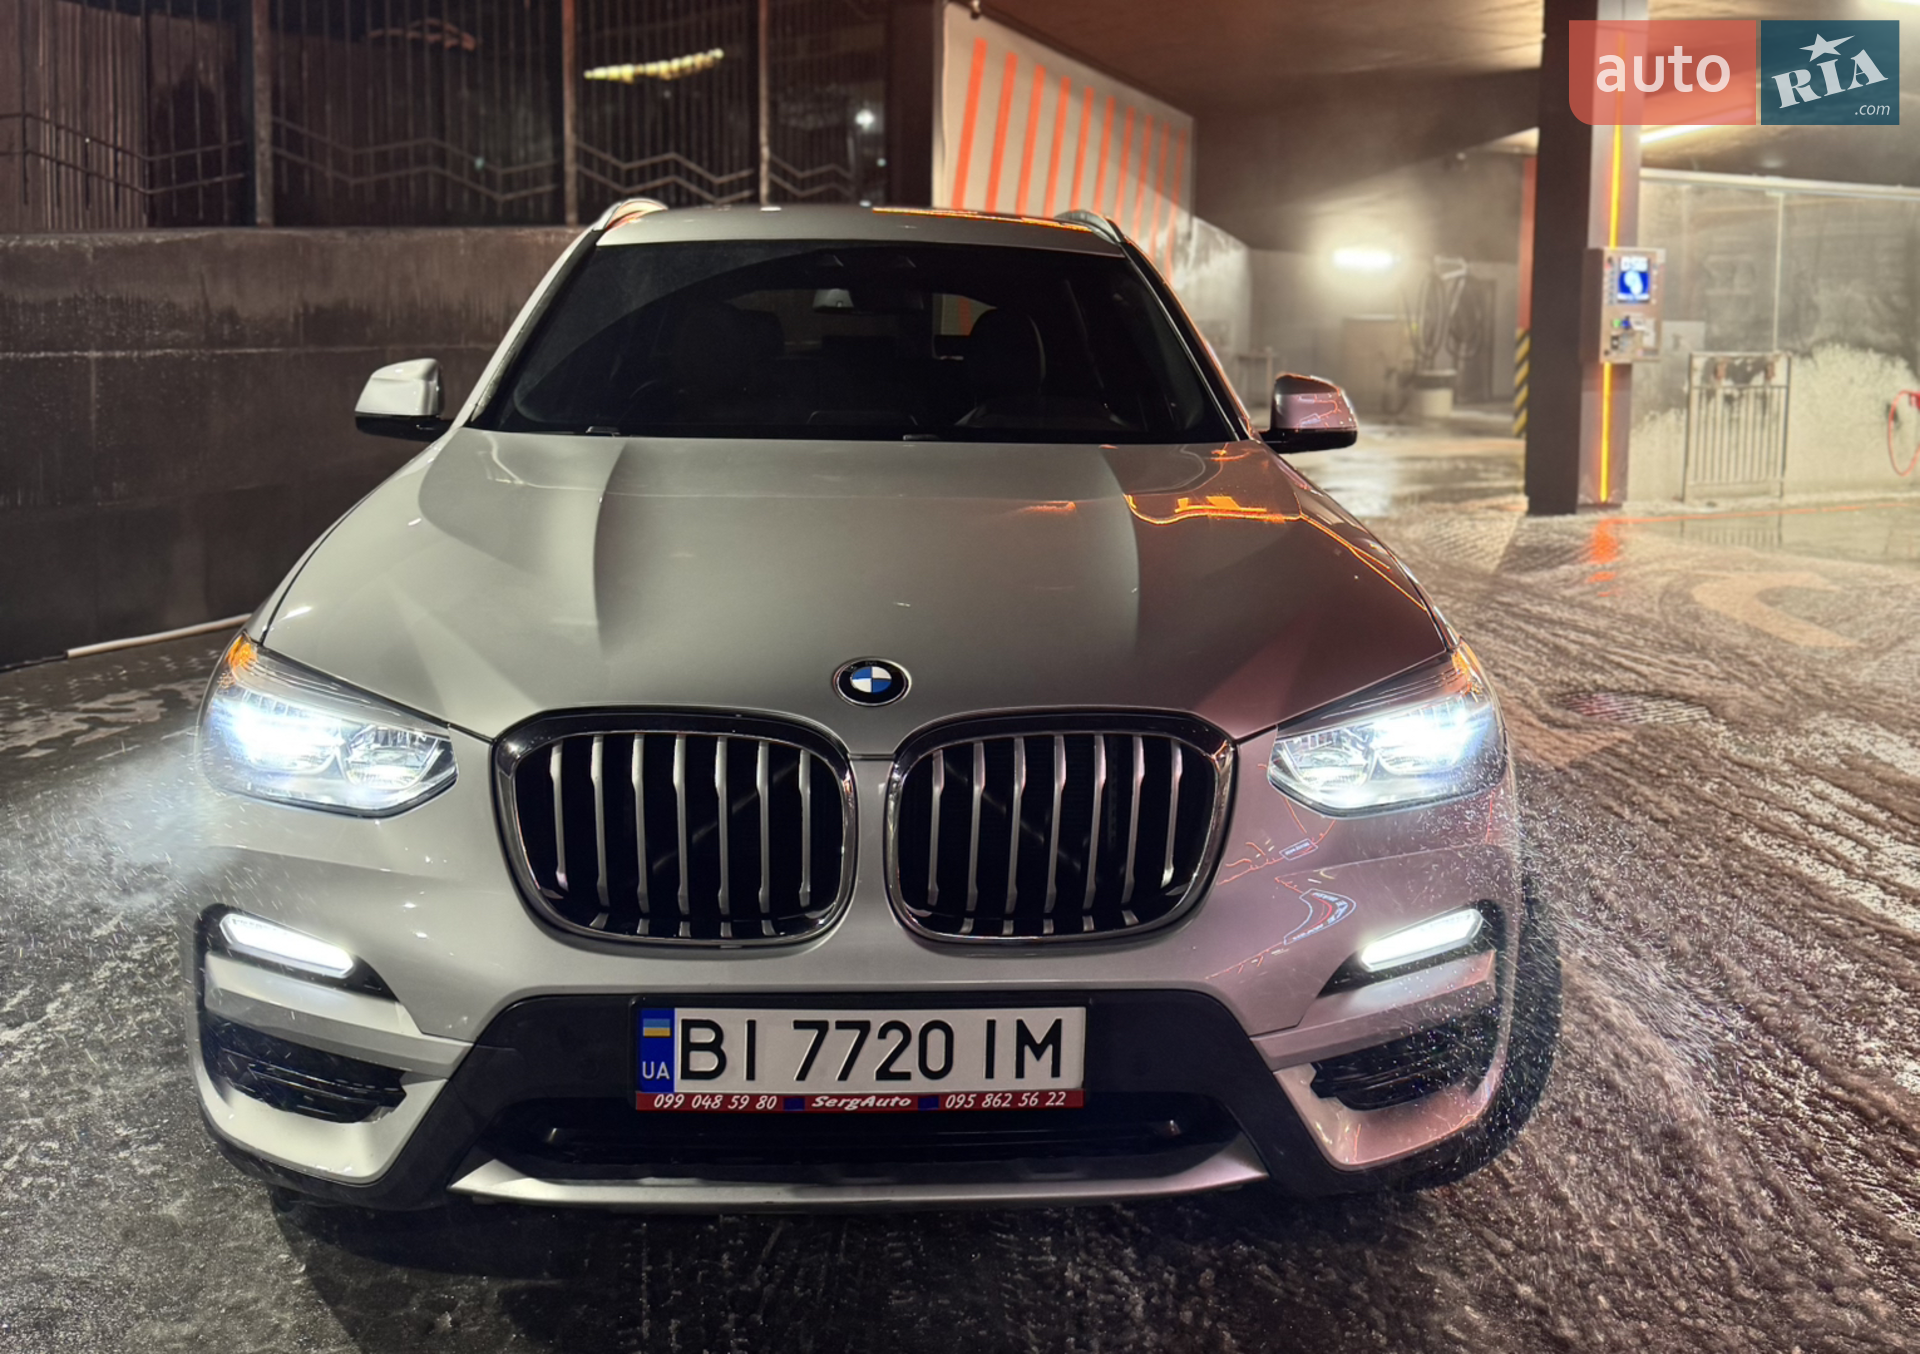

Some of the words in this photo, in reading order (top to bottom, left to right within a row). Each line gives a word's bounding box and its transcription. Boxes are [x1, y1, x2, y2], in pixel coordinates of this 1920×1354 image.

[680, 1018, 756, 1081] BI
[792, 1019, 954, 1081] 7720
[985, 1018, 1063, 1080] IM
[641, 1060, 671, 1080] UA
[653, 1093, 685, 1109] 099
[691, 1094, 723, 1109] 048
[727, 1095, 750, 1110] 59
[755, 1095, 778, 1110] 80
[811, 1095, 912, 1111] SergAuto
[945, 1093, 977, 1109] 095
[981, 1093, 1013, 1108] 862
[1018, 1092, 1040, 1107] 56
[1045, 1091, 1067, 1107] 22
